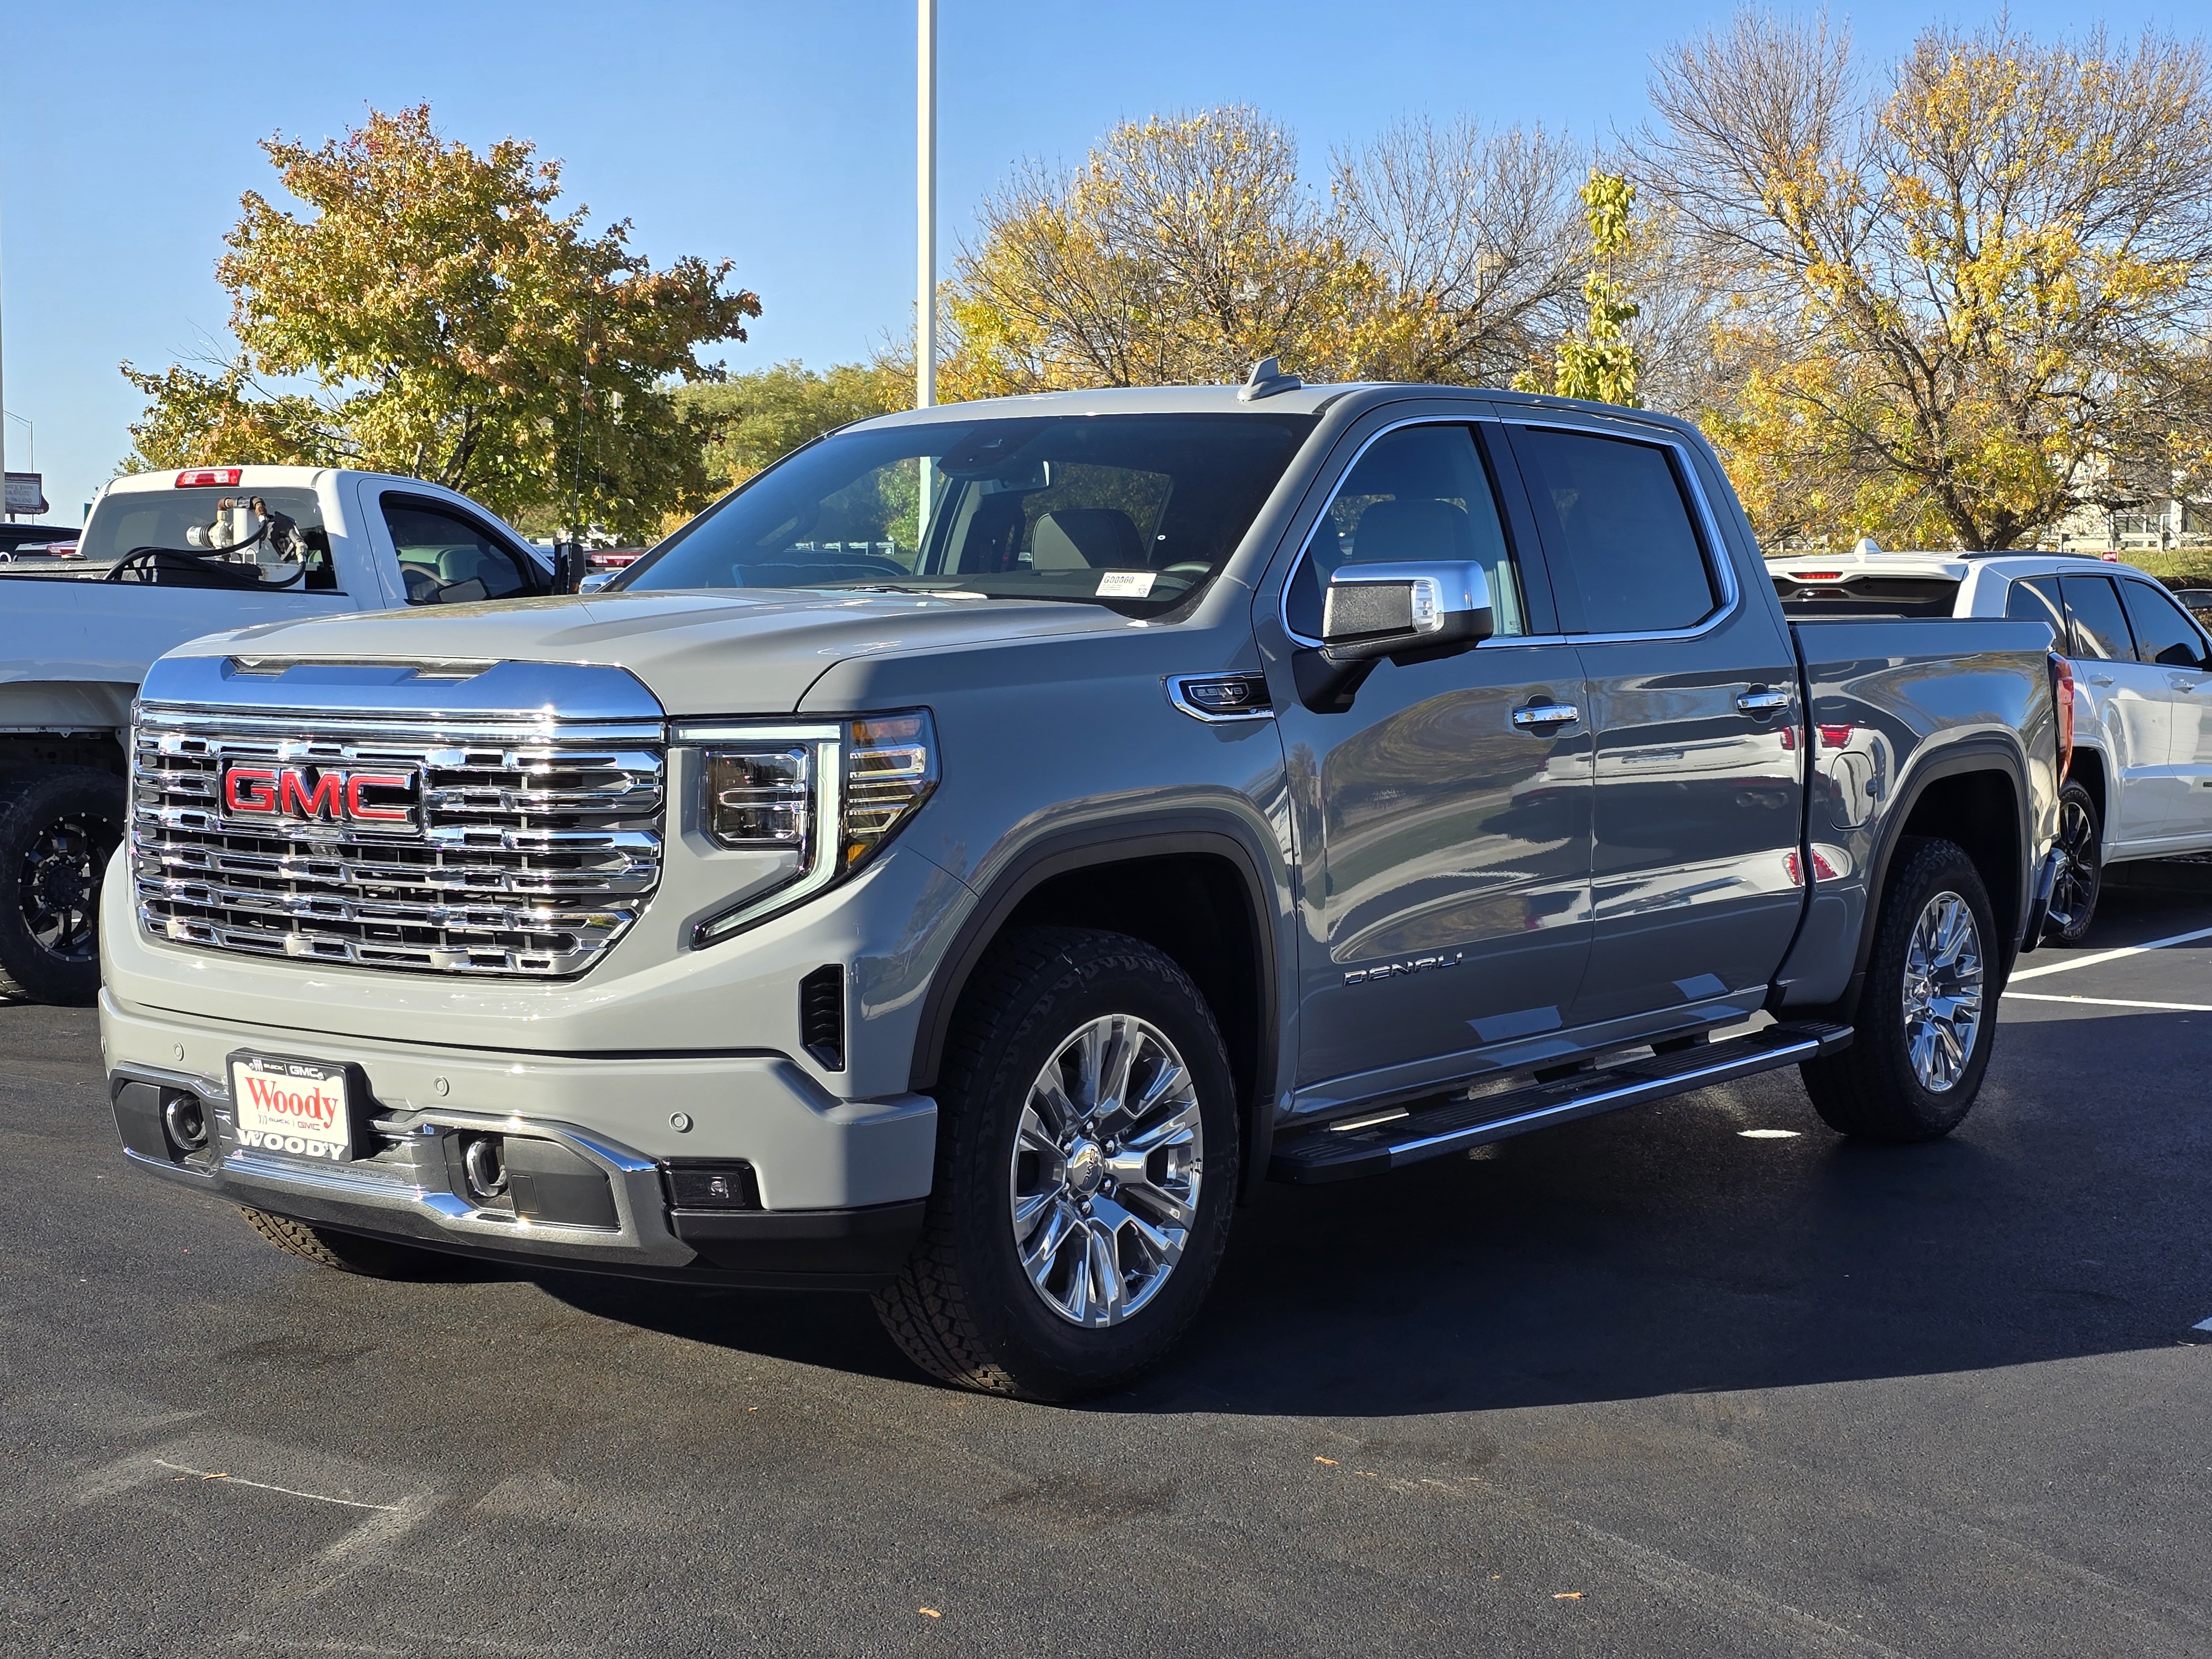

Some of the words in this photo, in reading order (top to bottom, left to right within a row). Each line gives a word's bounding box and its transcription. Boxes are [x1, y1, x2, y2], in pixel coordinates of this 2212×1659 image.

[226, 766, 413, 822] GMC
[1342, 952, 1463, 987] DENALI
[289, 1065, 319, 1078] GMC
[244, 1077, 338, 1129] Woody
[298, 1121, 321, 1131] GMC
[237, 1129, 345, 1160] WOODY
[1082, 1148, 1095, 1188] GMC
